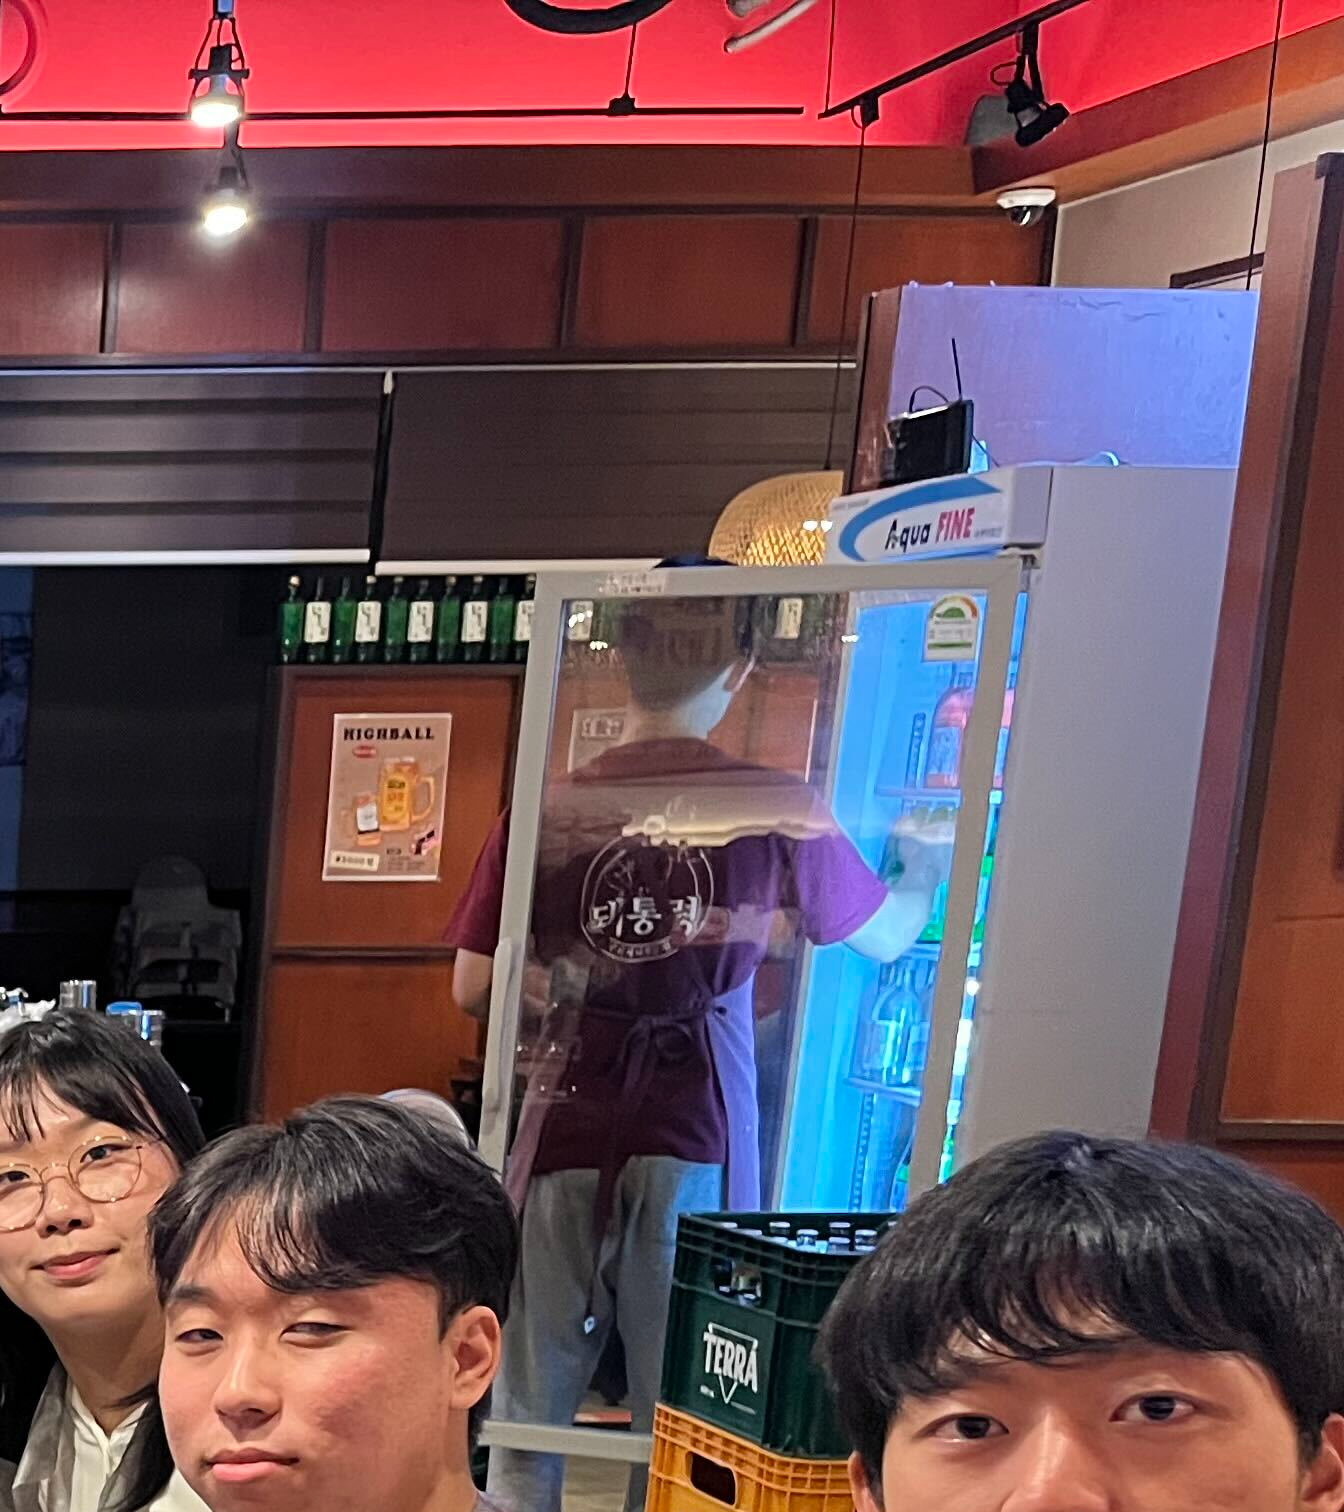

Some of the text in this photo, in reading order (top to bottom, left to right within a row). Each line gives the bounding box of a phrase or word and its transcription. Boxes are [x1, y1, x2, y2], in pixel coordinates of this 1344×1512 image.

[885, 507, 975, 553] Aqua FINE
[343, 727, 435, 741] HIGHBALL
[703, 1332, 758, 1393] TERRA
